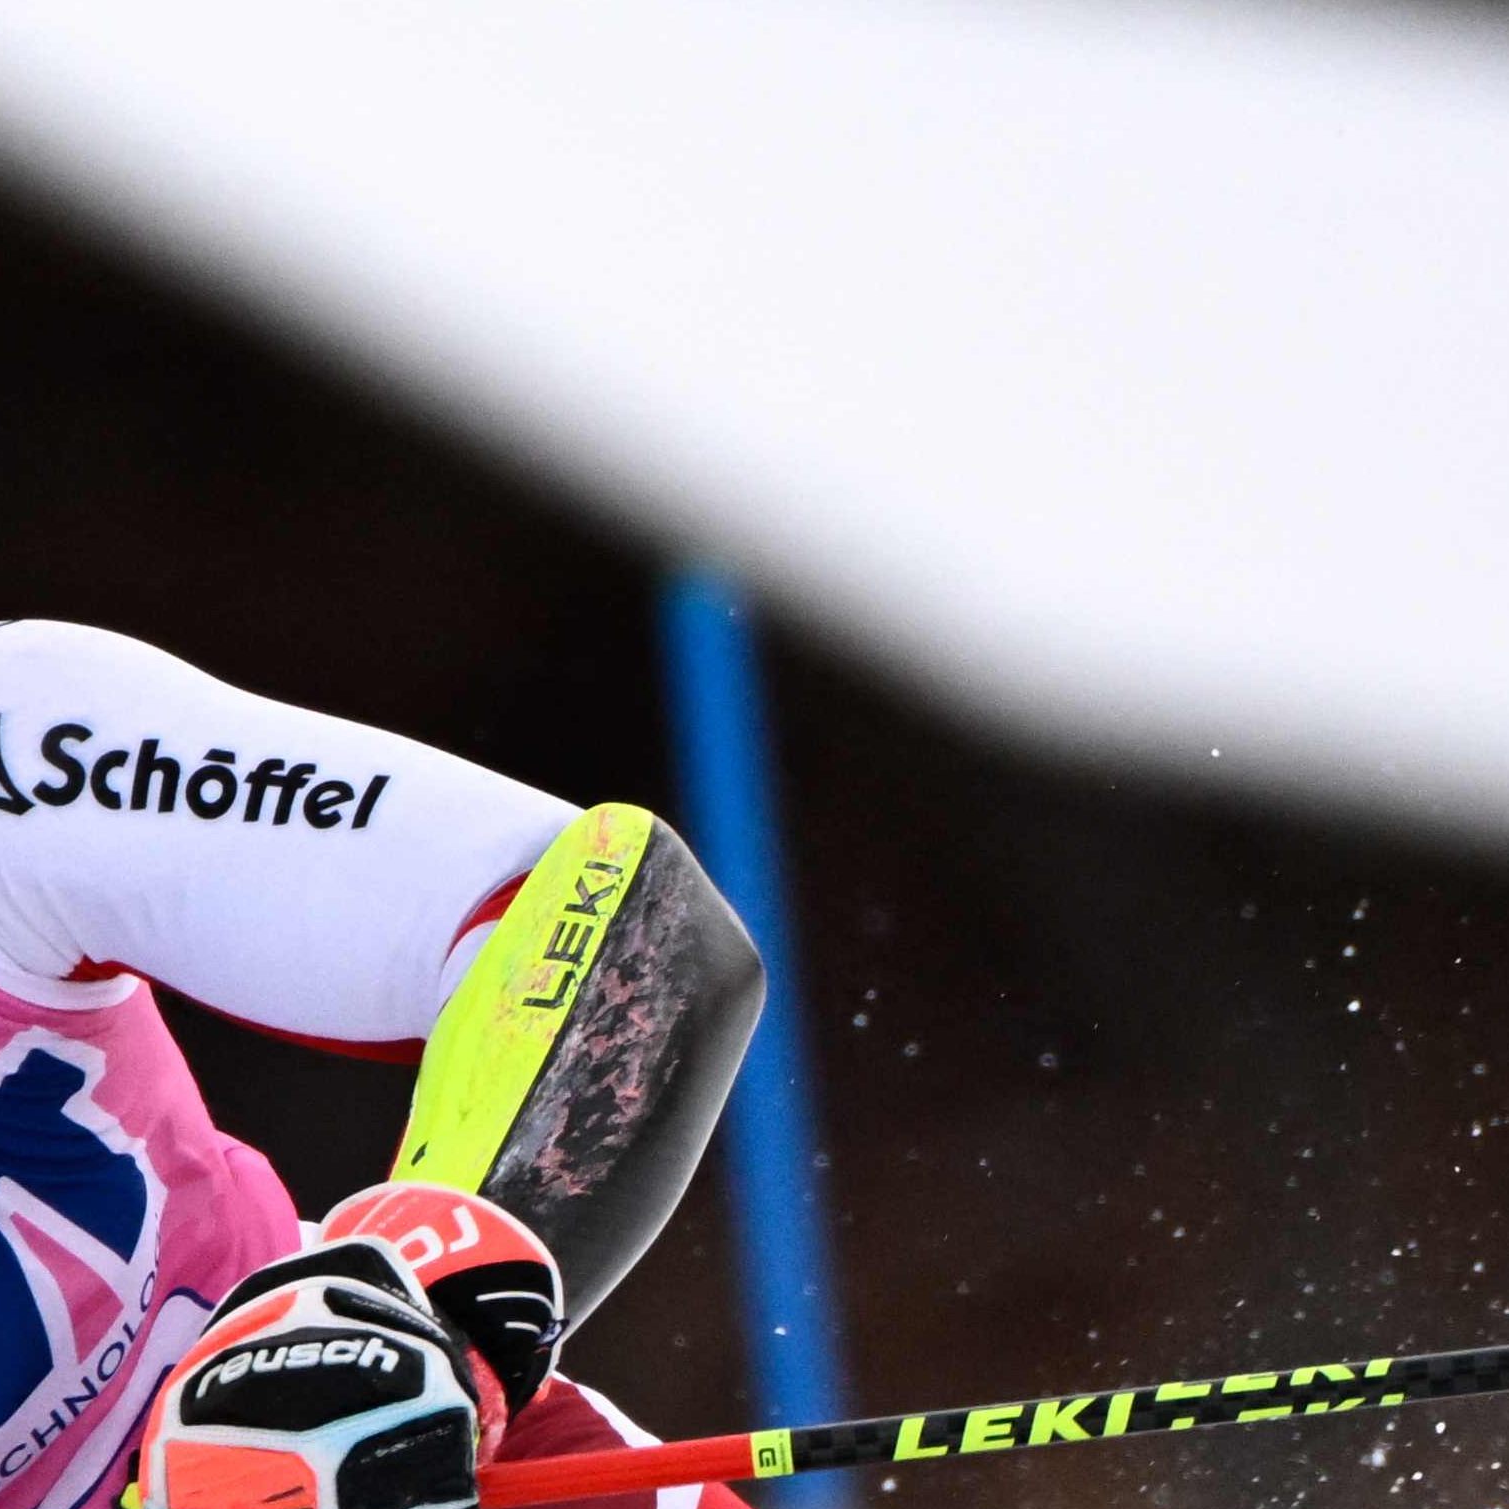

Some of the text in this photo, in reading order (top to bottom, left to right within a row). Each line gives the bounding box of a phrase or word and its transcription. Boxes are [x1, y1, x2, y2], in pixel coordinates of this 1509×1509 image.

[523, 859, 624, 1011] LEKI
[196, 1337, 401, 1400] reusch
[893, 1393, 1134, 1461] LEKI
